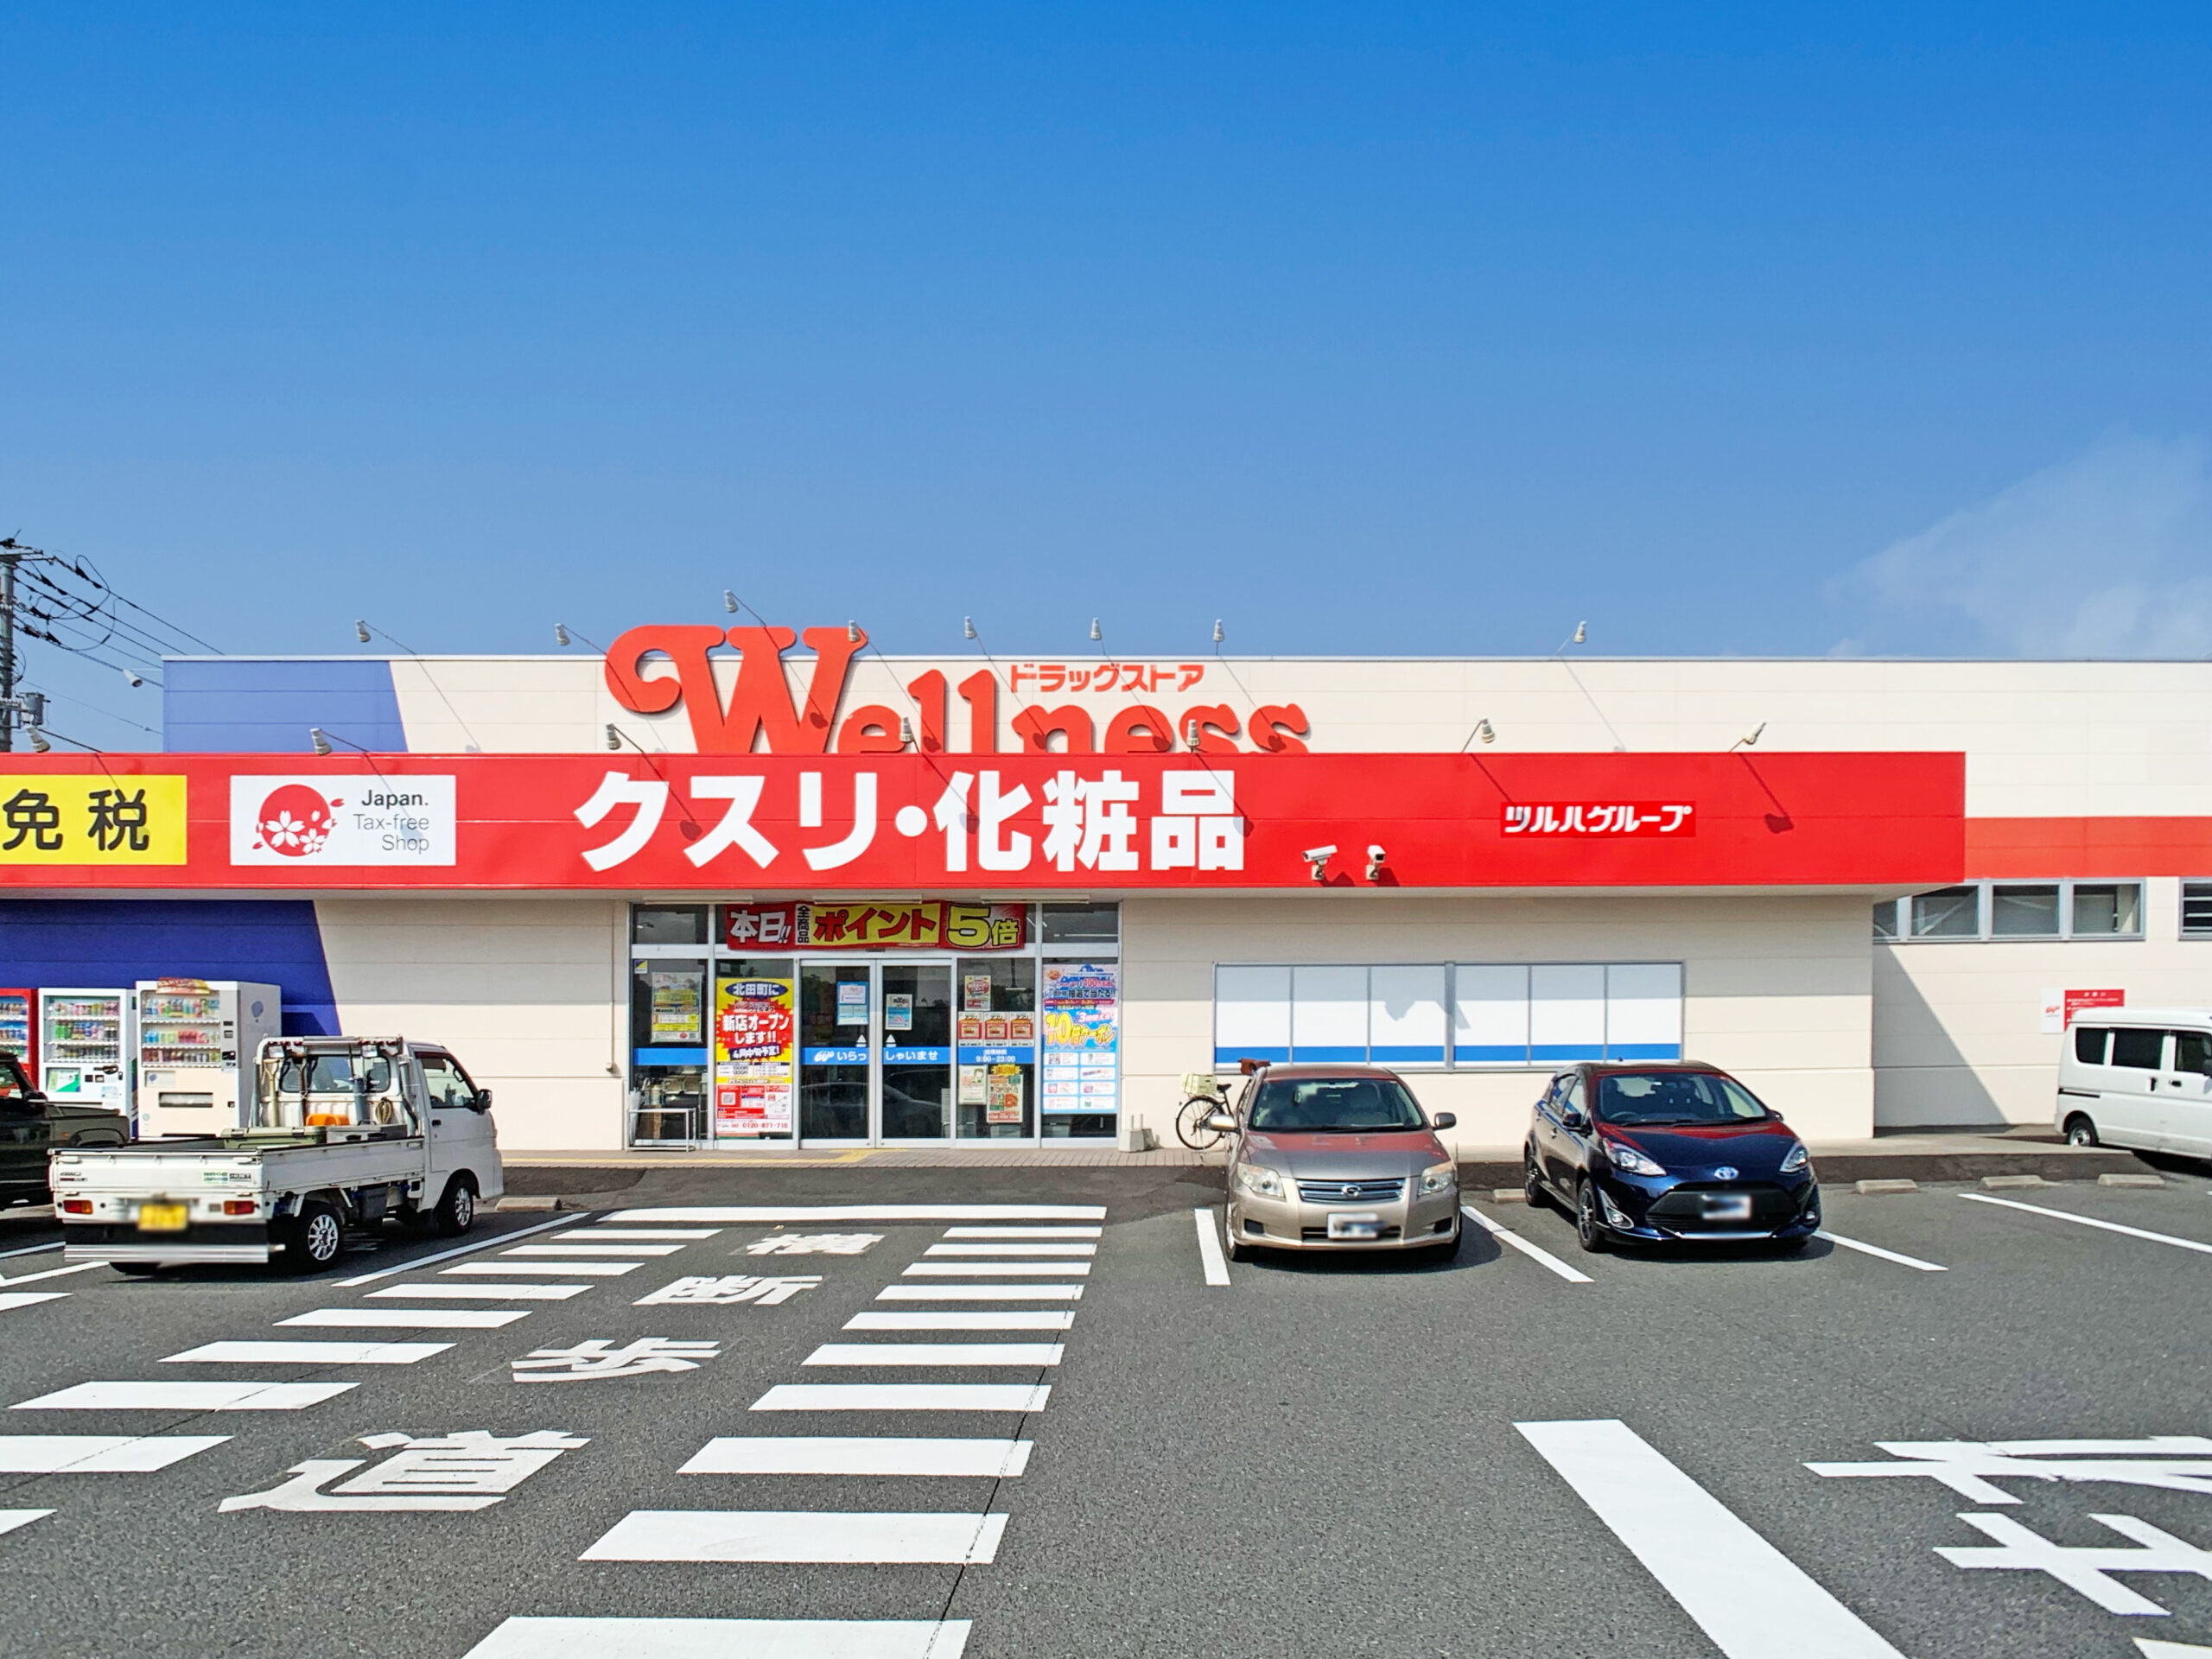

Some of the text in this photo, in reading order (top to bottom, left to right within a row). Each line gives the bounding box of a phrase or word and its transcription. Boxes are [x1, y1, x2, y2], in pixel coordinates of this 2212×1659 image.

[606, 625, 1313, 753] Wellness
[1010, 664, 1205, 693] ドラッグストア
[360, 789, 429, 809] Japan.
[2, 788, 150, 851] 免税
[353, 814, 429, 831] Tax-free
[574, 770, 1245, 872] クスリ・化粧品
[1504, 805, 1693, 833] ツルハグループ
[382, 834, 429, 853] Shop
[797, 906, 810, 944] 全商品
[814, 907, 938, 942] ポイント
[733, 983, 779, 995] 北田町に
[722, 1013, 790, 1032] 新店オープン
[734, 1031, 777, 1044] します!!
